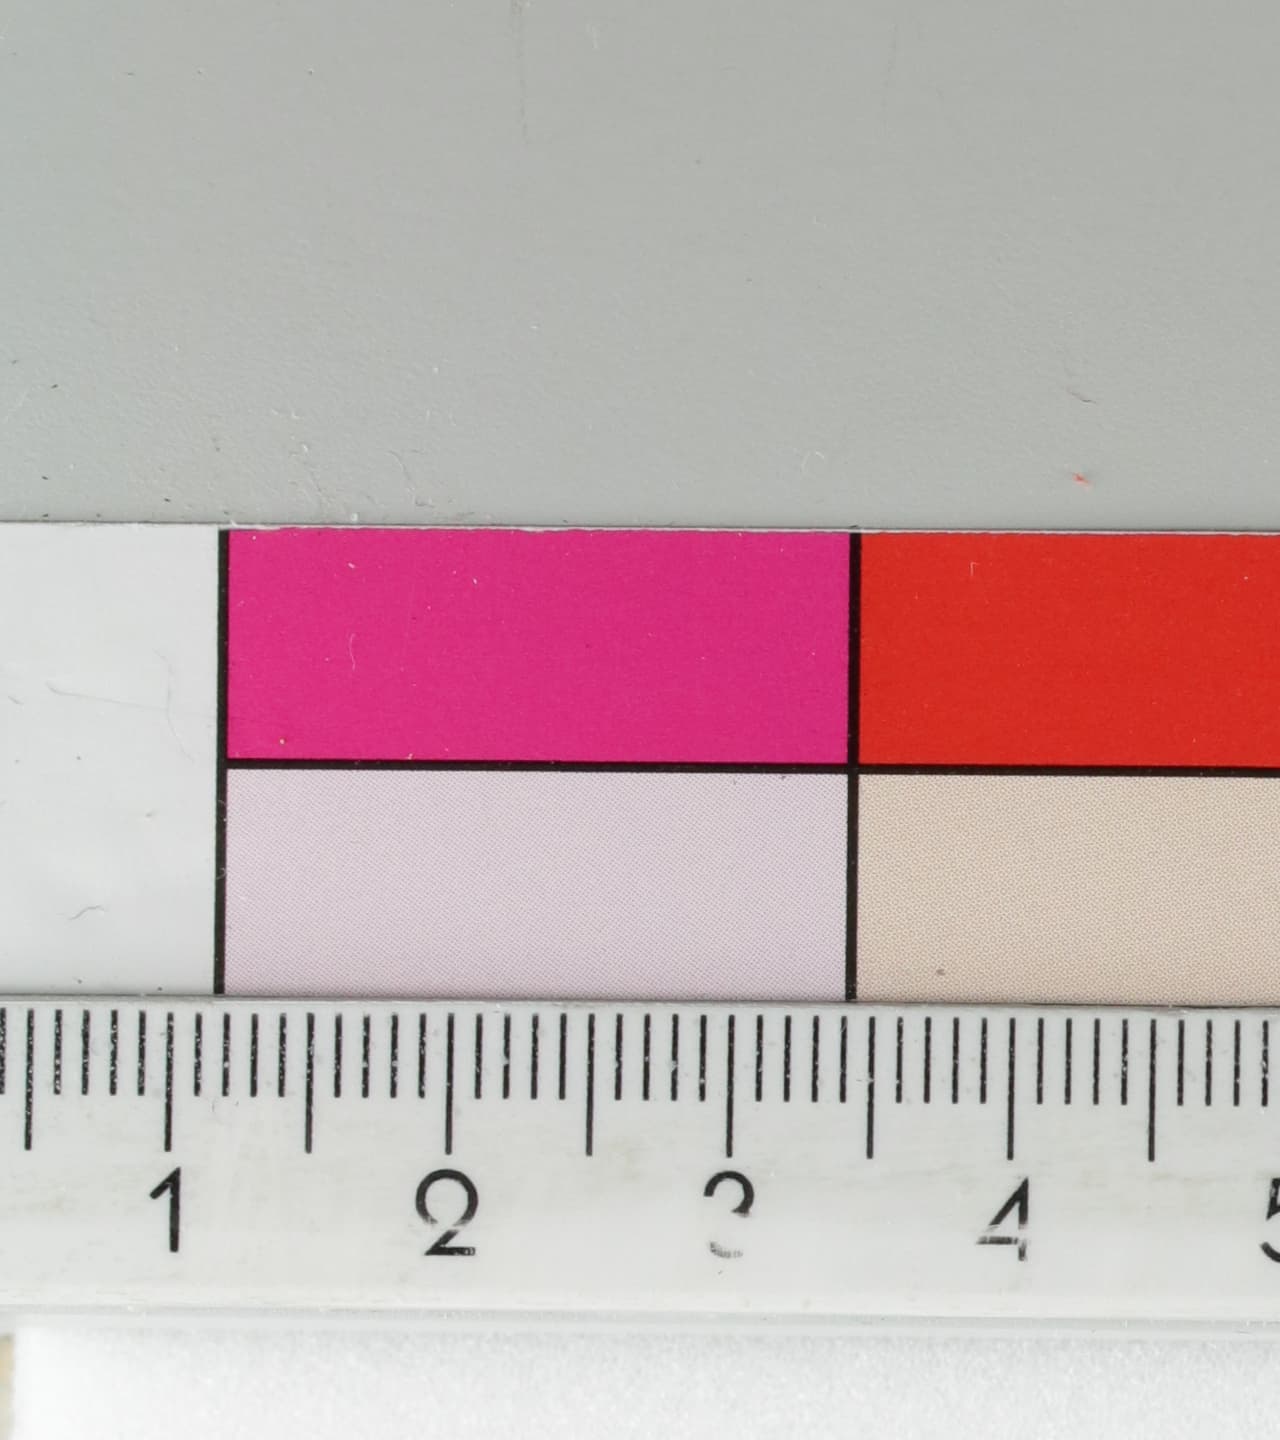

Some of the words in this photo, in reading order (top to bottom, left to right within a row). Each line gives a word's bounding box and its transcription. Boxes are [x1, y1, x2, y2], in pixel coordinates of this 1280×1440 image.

[148, 1166, 182, 1254] 1
[414, 1167, 480, 1257] 2
[702, 1169, 756, 1259] 3
[976, 1176, 1030, 1262] 4
